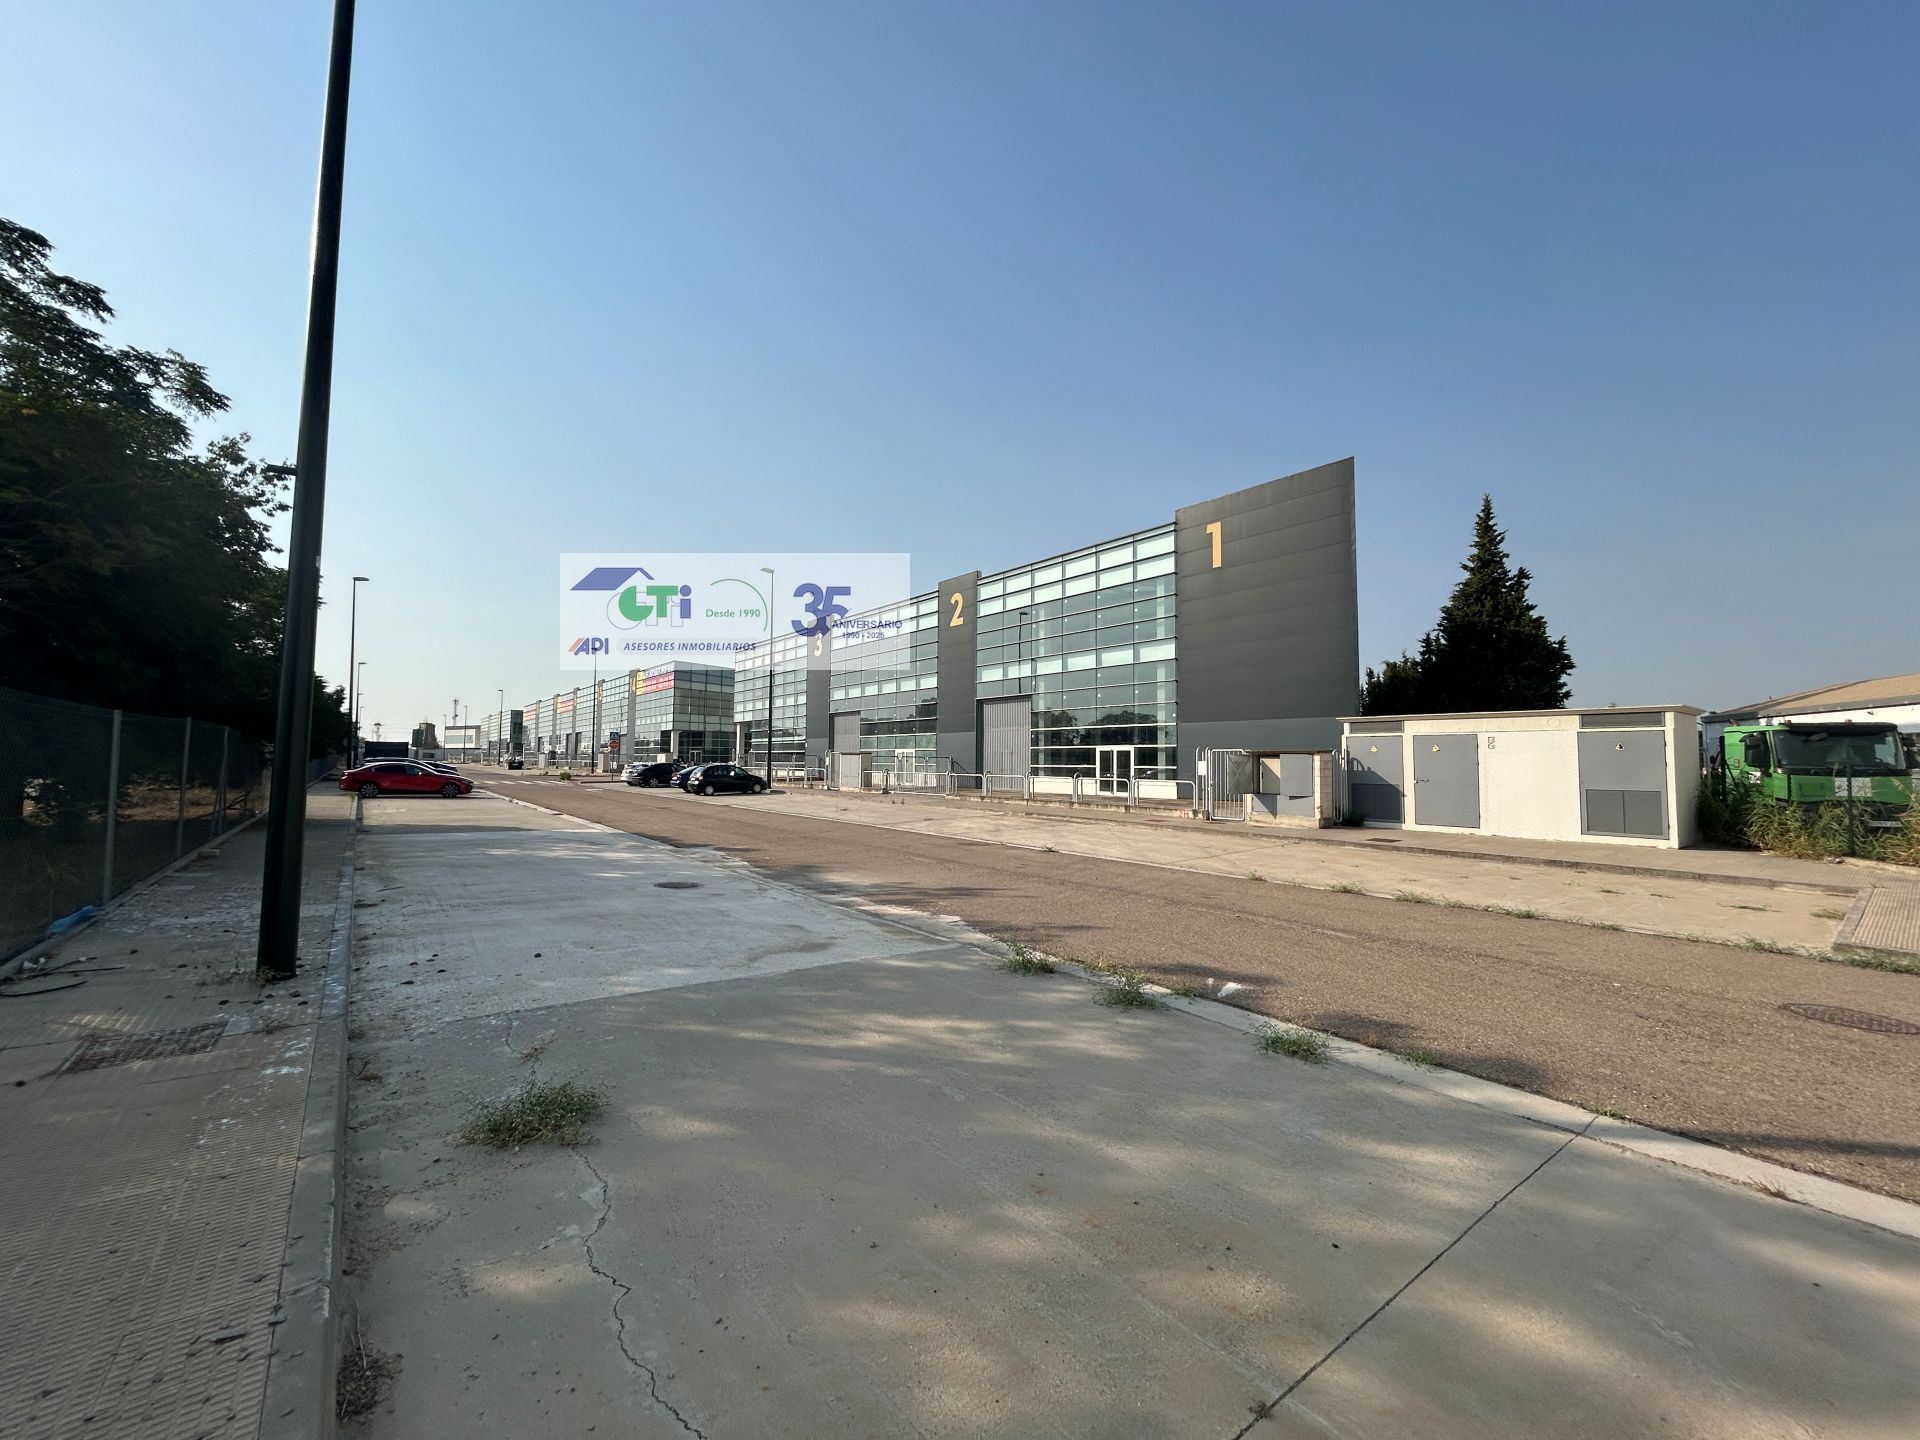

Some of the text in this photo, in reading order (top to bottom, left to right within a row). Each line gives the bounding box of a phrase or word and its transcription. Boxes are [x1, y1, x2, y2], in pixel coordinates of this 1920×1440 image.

[1206, 521, 1222, 569] 1
[949, 592, 964, 627] 2
[814, 631, 823, 657] 3
